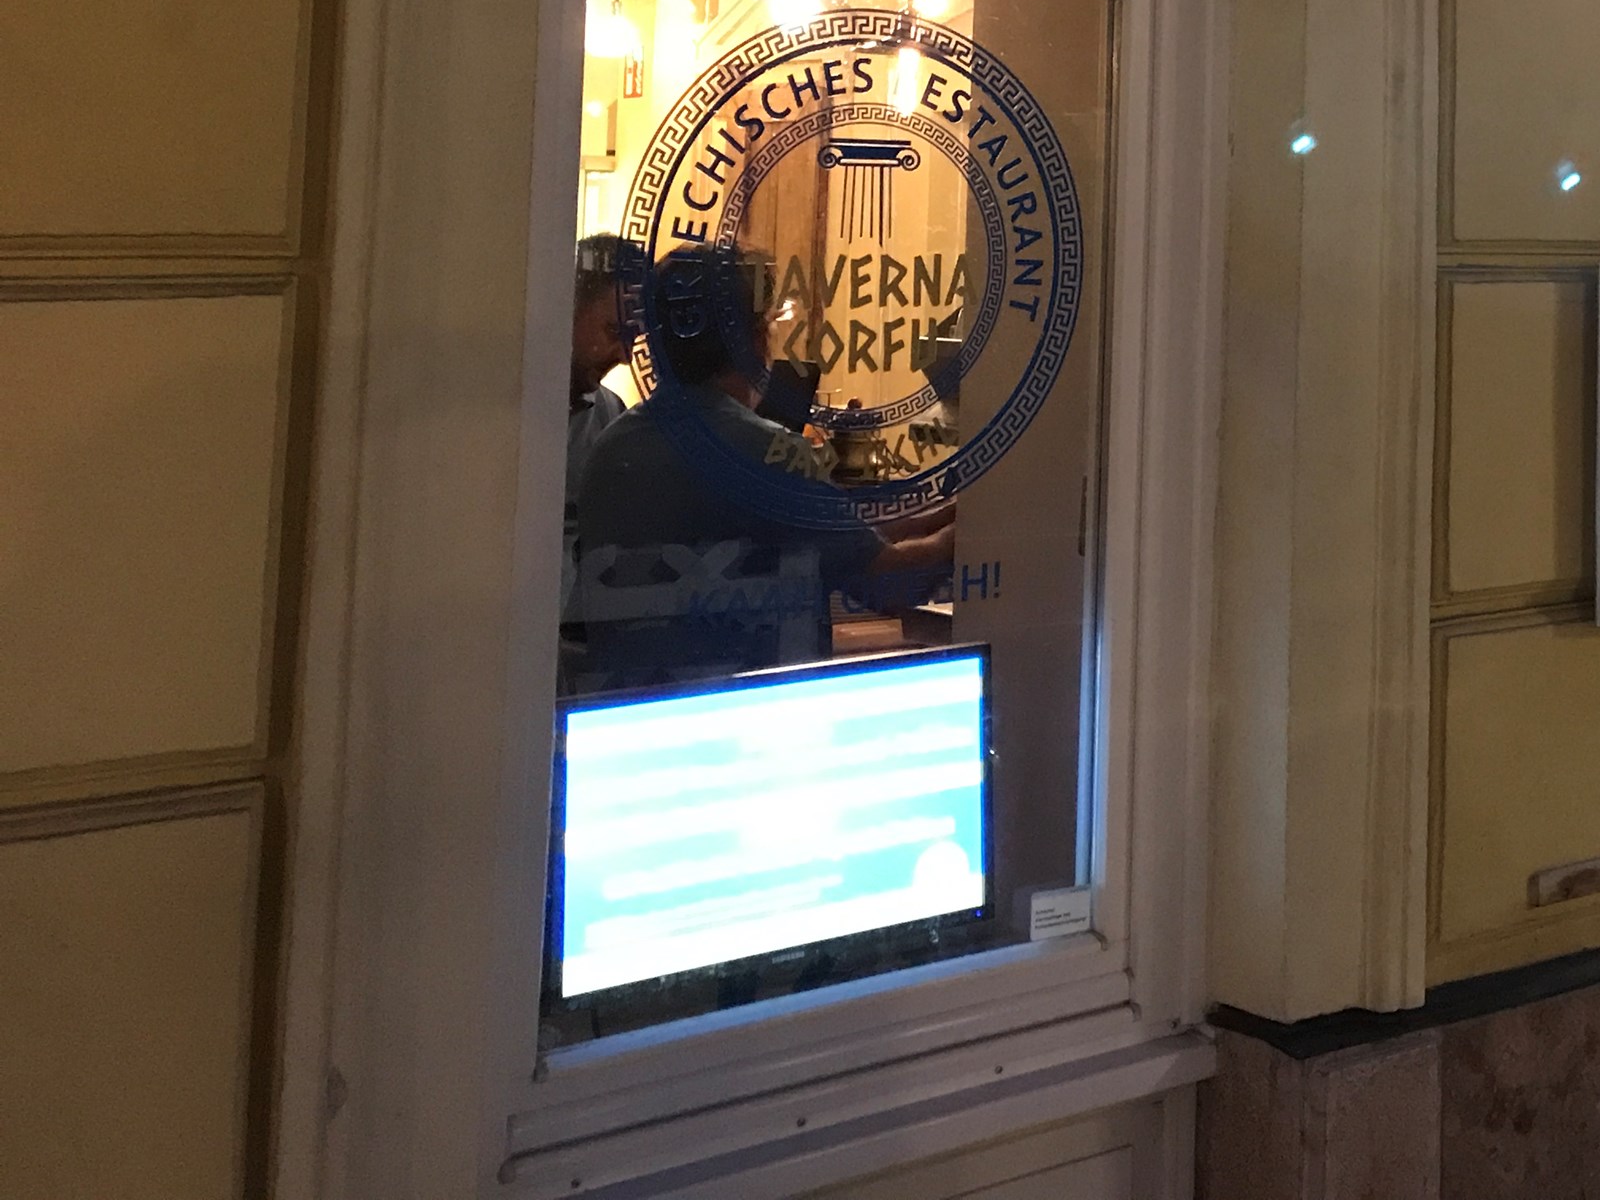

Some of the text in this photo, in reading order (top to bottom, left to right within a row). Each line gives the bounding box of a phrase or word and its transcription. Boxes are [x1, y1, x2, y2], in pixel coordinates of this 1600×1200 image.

[919, 70, 1043, 323] ESTAURANT
[747, 253, 978, 314] TAVERNA
[783, 315, 941, 378] CORFU
